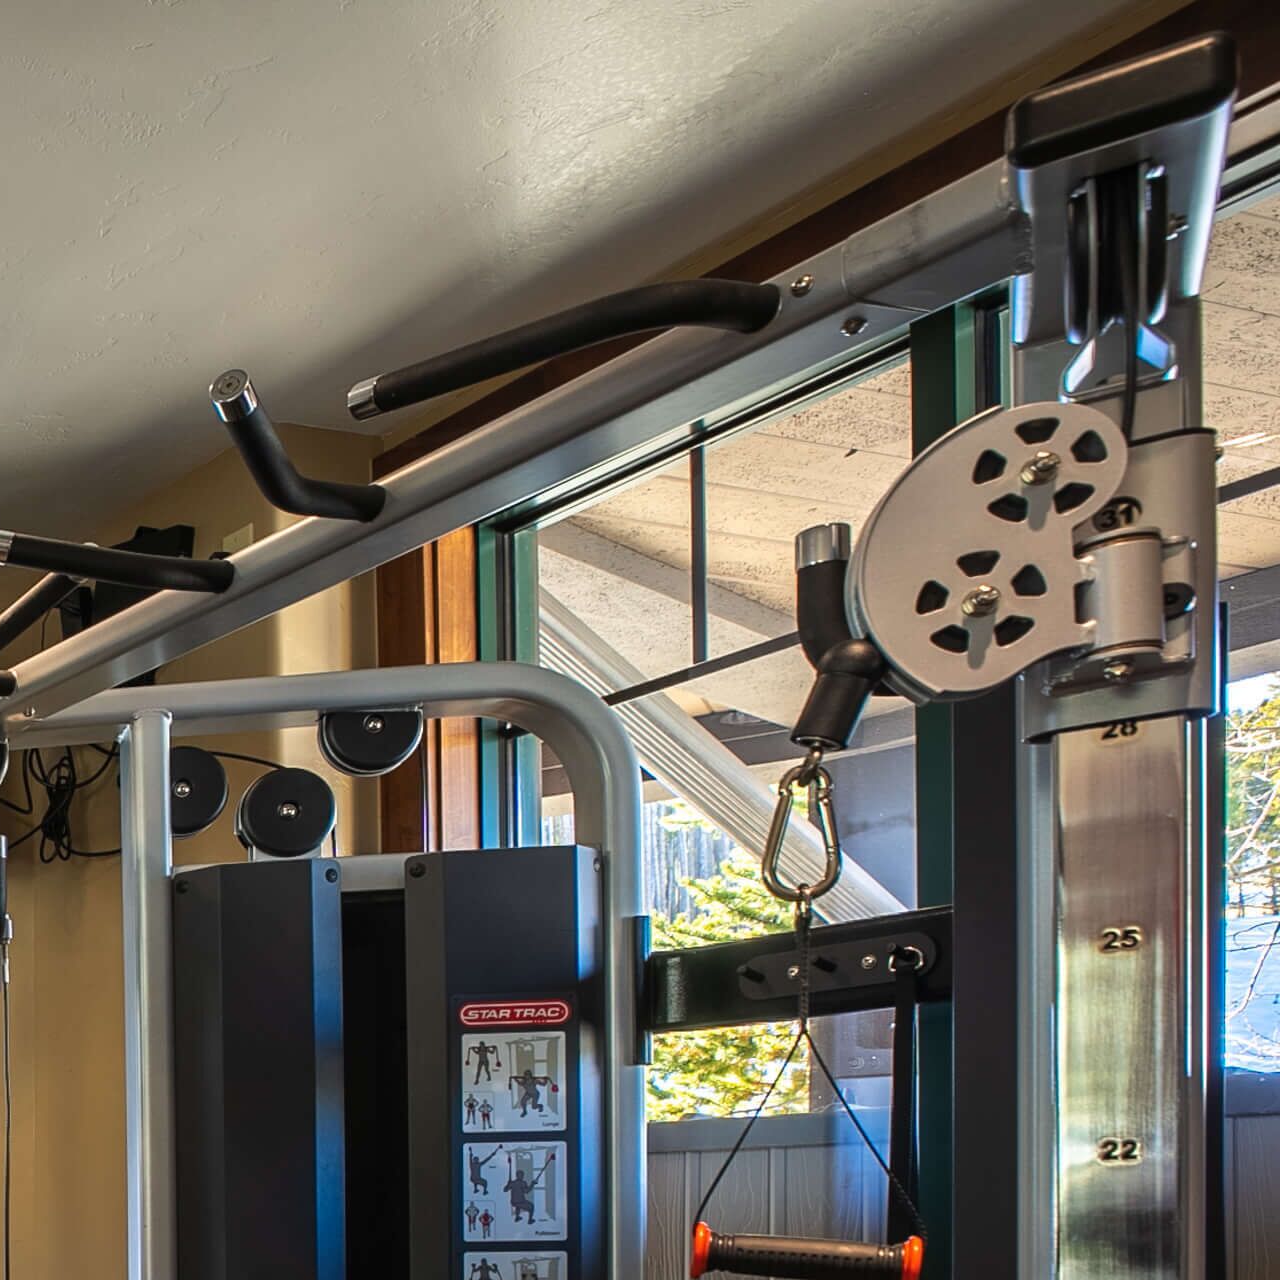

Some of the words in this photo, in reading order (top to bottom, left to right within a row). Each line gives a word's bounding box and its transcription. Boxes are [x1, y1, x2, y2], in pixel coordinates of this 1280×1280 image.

[1100, 505, 1133, 528] 31
[1100, 720, 1139, 740] 28
[1100, 928, 1140, 950] 25
[466, 1008, 511, 1020] STAR
[513, 1007, 560, 1018] TRAC
[1099, 1140, 1139, 1160] 22
